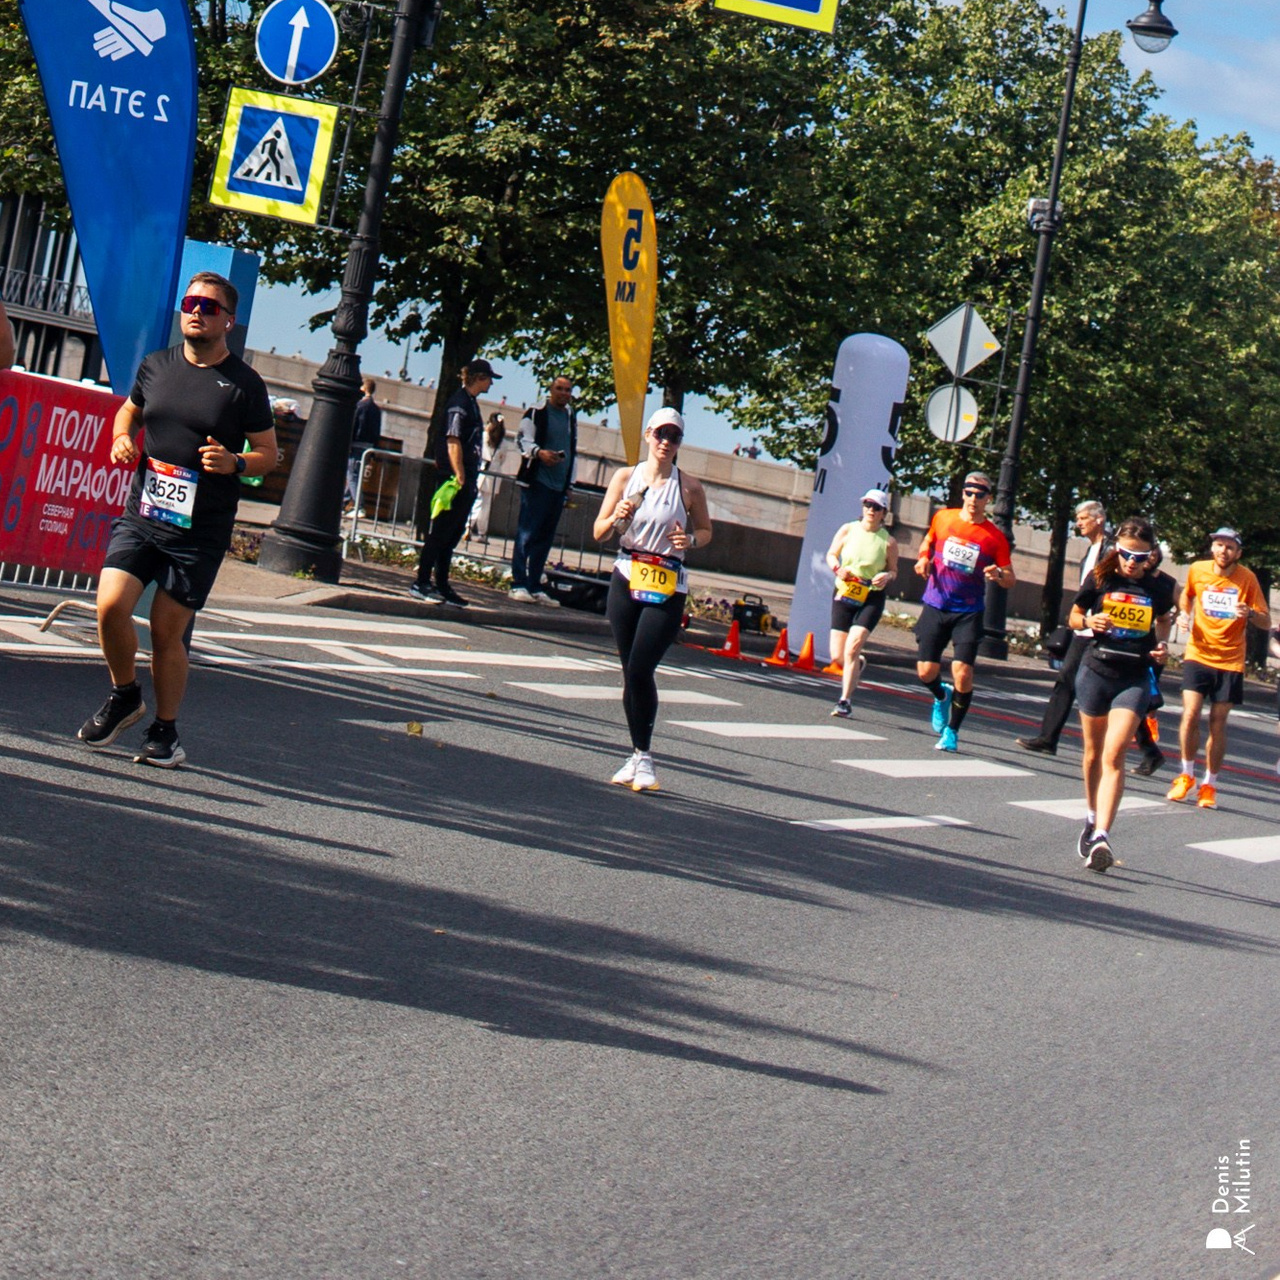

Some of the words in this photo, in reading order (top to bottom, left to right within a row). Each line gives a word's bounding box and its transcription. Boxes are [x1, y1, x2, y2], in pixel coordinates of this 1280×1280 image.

[46, 406, 106, 453] ПОЛУ
[35, 453, 135, 506] МАРАФОН
[149, 477, 188, 503] 3525
[42, 503, 75, 520] СЕВЕРНАЯ
[39, 519, 68, 535] СТОЛИЦА
[948, 545, 974, 562] 4892
[640, 567, 668, 585] 910
[1208, 594, 1233, 607] 5441
[1109, 605, 1146, 623] 4652
